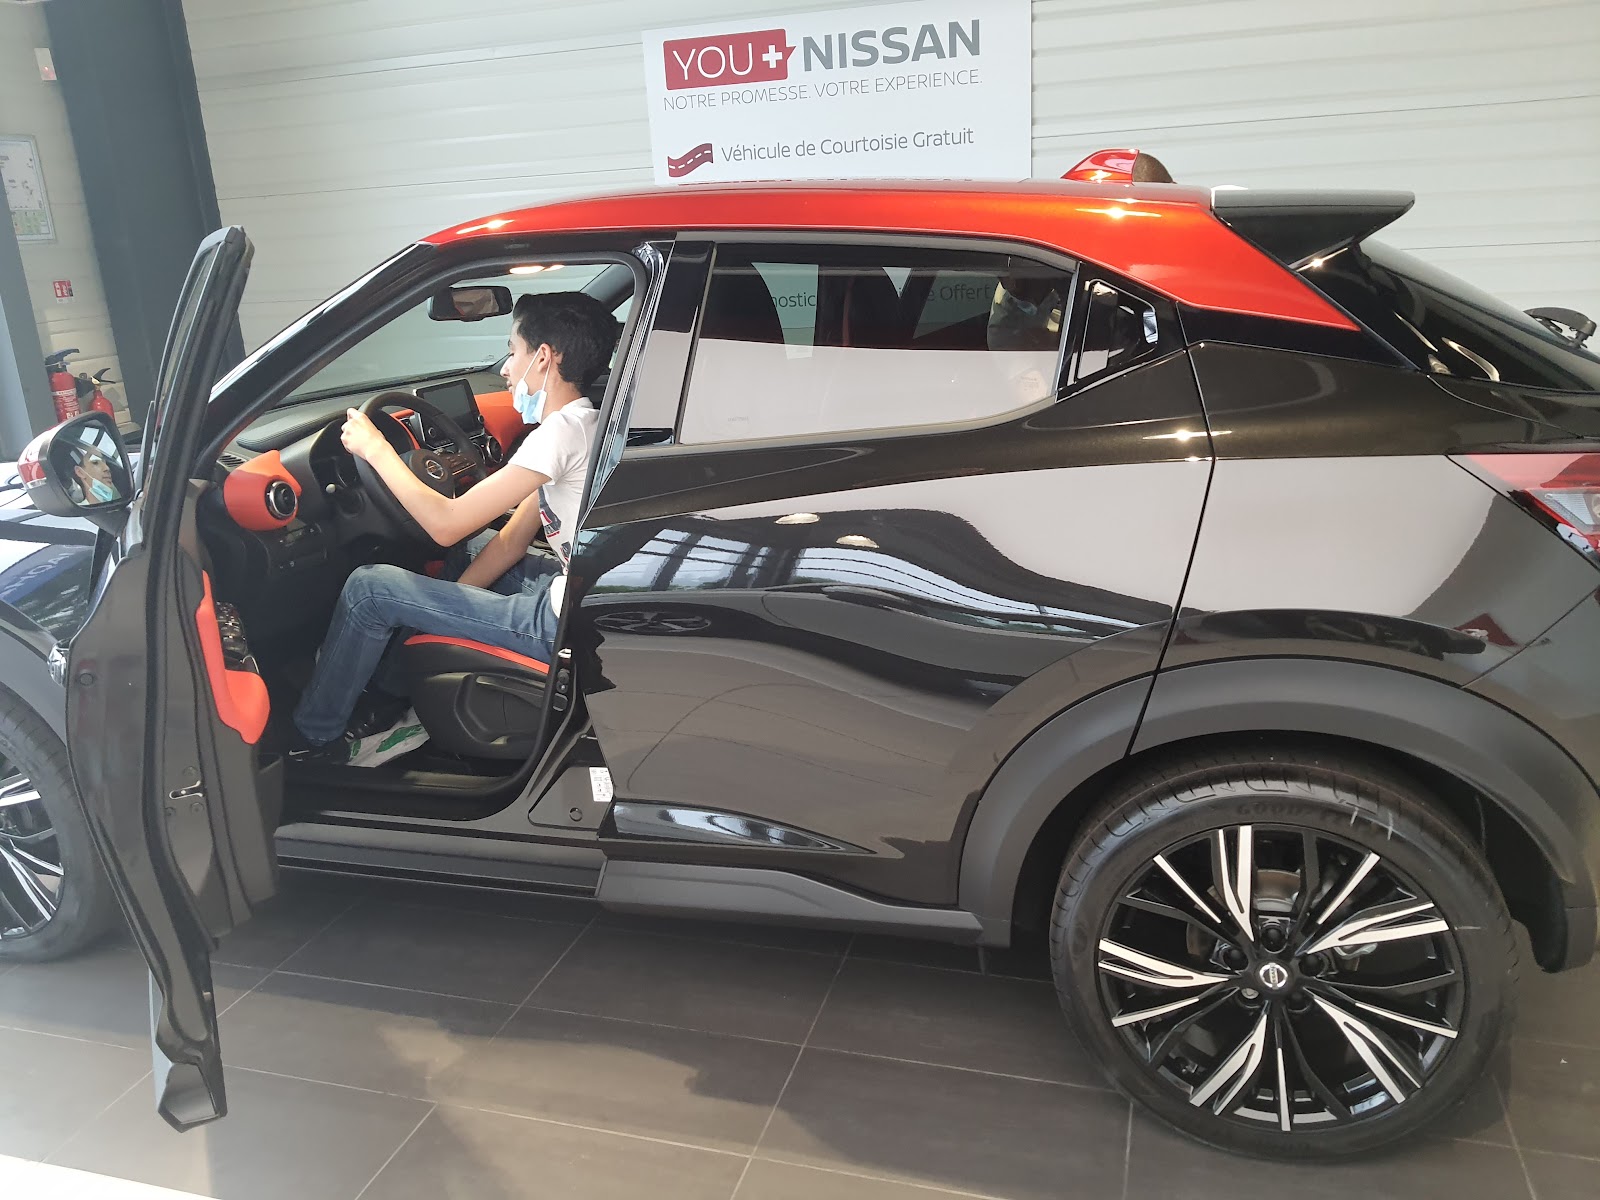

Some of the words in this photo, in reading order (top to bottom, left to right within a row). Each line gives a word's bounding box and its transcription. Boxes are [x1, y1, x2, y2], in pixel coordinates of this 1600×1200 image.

[672, 42, 753, 80] YOU
[802, 19, 981, 72] NISSAN
[664, 92, 717, 111] NOTRE
[721, 84, 811, 106] PROMESSE.
[814, 78, 870, 98] VOTRE
[875, 68, 983, 93] EXPERIENCE.
[721, 141, 791, 162] Véhicule
[795, 139, 816, 157] de
[820, 133, 908, 155] Courtoisie
[912, 127, 974, 148] Gratuit
[940, 283, 992, 301] Offert
